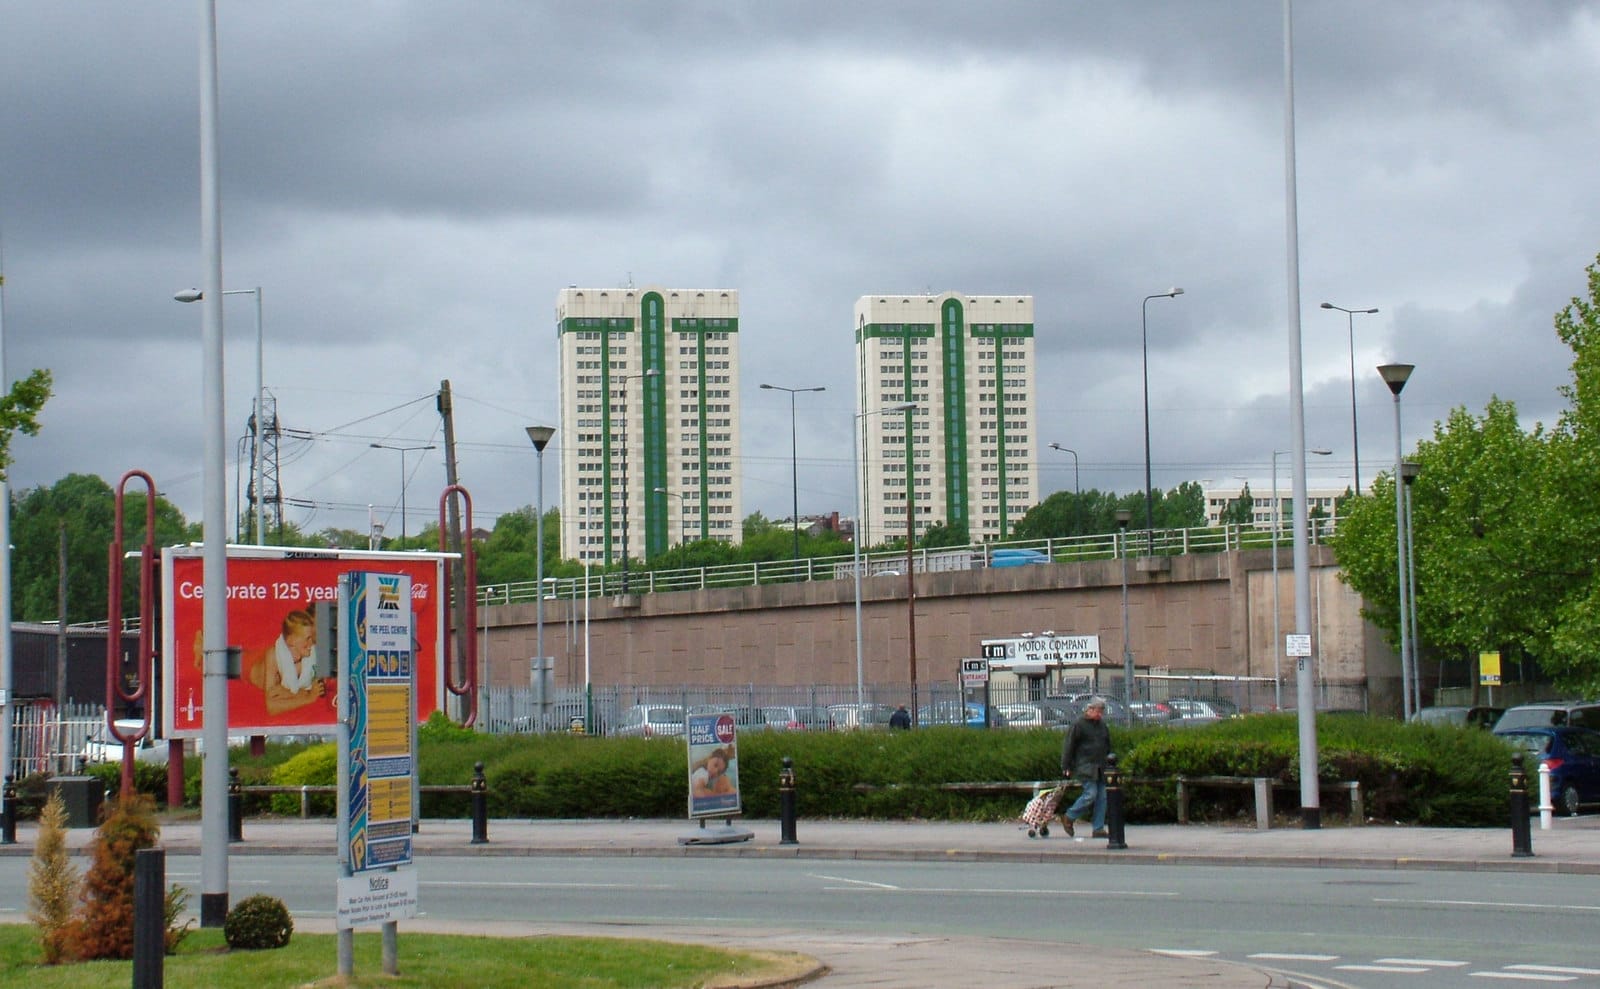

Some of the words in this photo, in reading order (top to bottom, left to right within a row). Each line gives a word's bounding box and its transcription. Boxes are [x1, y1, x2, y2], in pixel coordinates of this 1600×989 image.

[180, 582, 266, 599] Cerate
[272, 583, 300, 599] 125
[305, 585, 339, 602] year
[985, 645, 1014, 657] tmc
[1018, 640, 1047, 653] MOTOR
[1049, 639, 1089, 651] COMPANY
[1064, 652, 1077, 660] 477
[691, 725, 710, 735] HALF
[717, 724, 733, 735] SALE
[691, 734, 714, 745] PRICE
